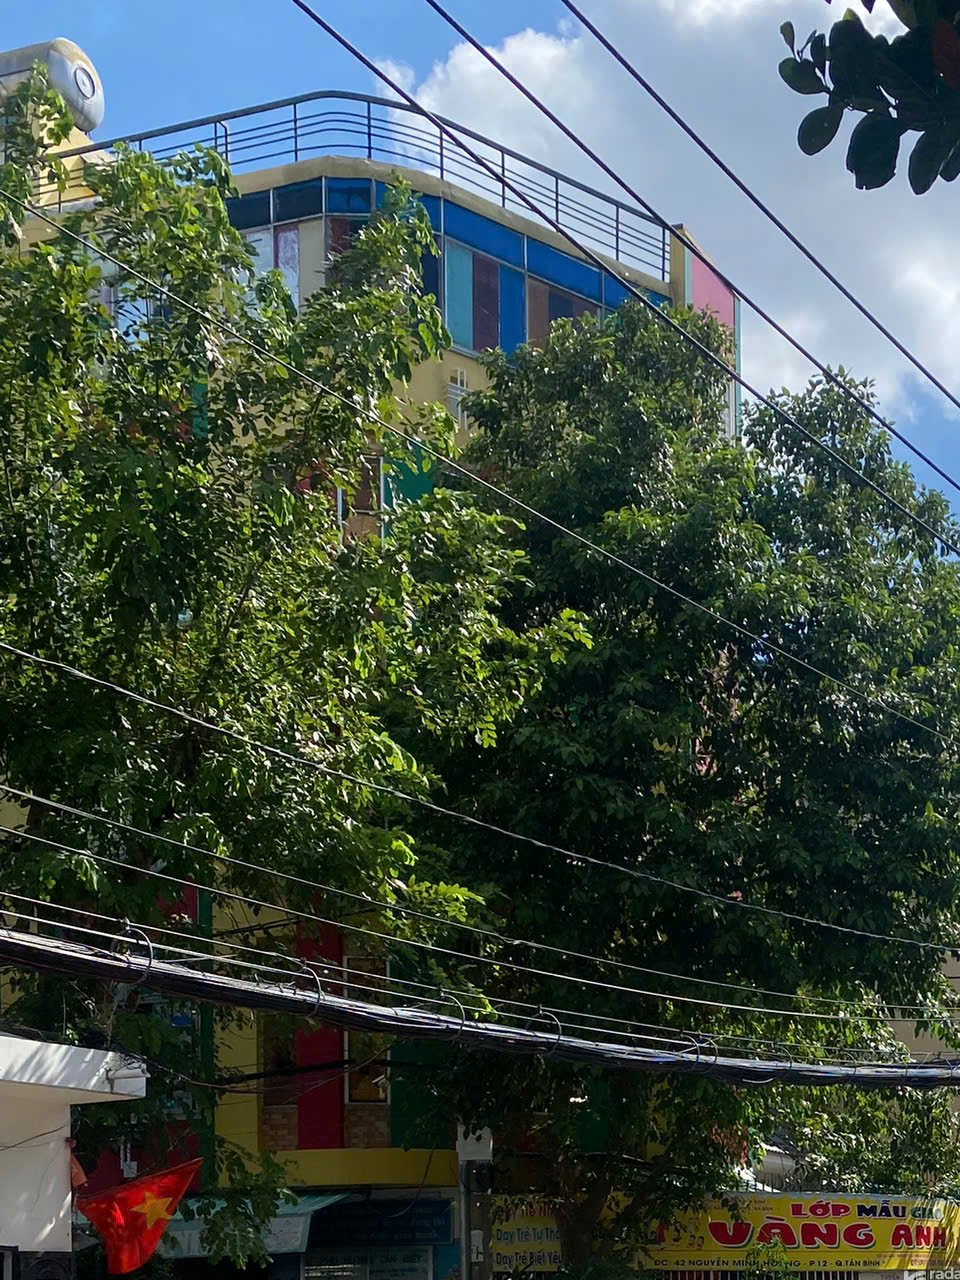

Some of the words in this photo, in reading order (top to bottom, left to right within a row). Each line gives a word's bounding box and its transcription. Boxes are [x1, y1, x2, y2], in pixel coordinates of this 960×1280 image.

[791, 1199, 850, 1218] LỚP
[857, 1199, 907, 1218] MẪU
[707, 1215, 875, 1249] VÀNG
[891, 1223, 947, 1249] ANH
[675, 1258, 686, 1267] 42
[763, 1258, 801, 1268] HONG
